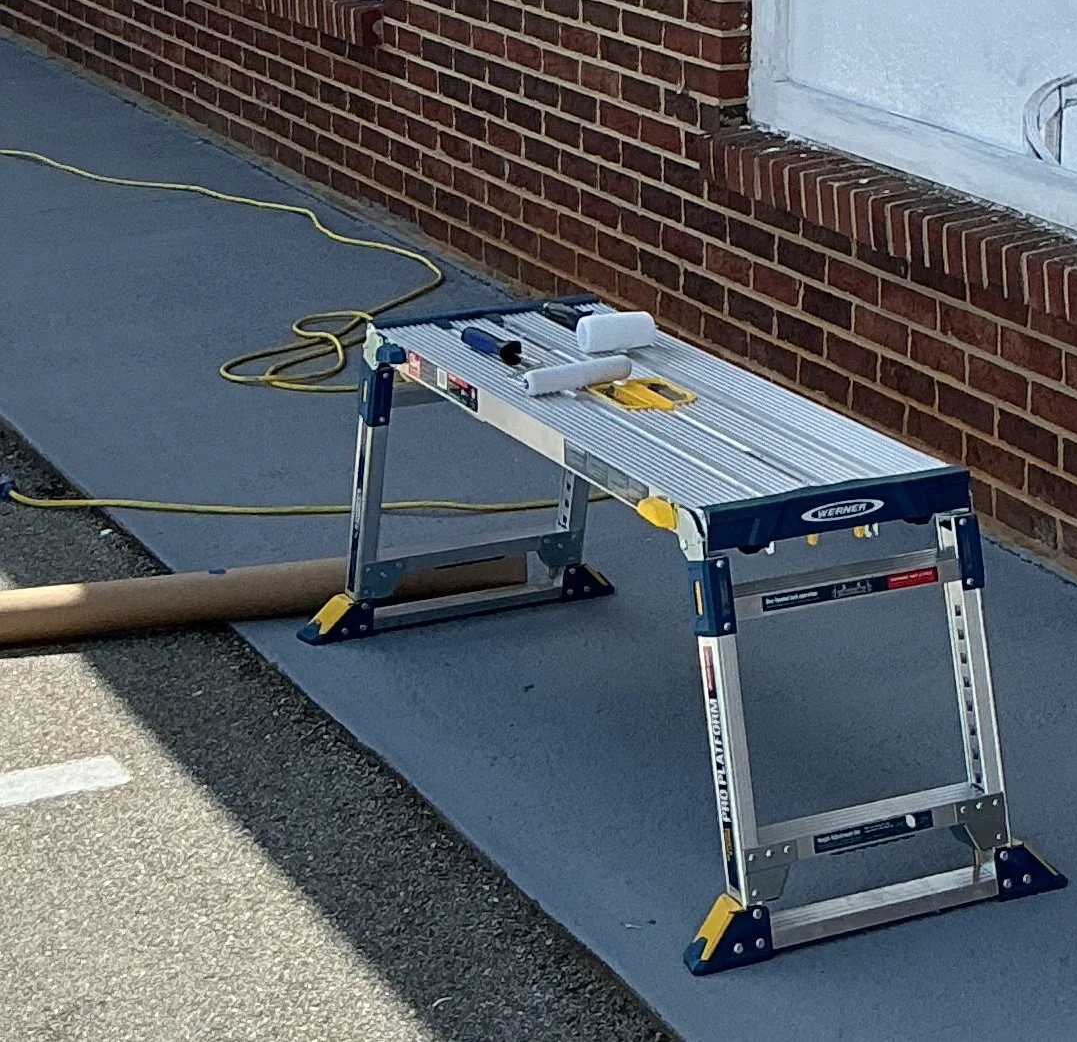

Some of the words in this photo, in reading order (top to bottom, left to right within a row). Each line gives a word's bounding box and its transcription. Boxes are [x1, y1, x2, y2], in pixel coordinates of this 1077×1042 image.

[817, 503, 867, 518] WERNER
[709, 698, 727, 786] PLATFORM
[720, 789, 732, 823] PRO
